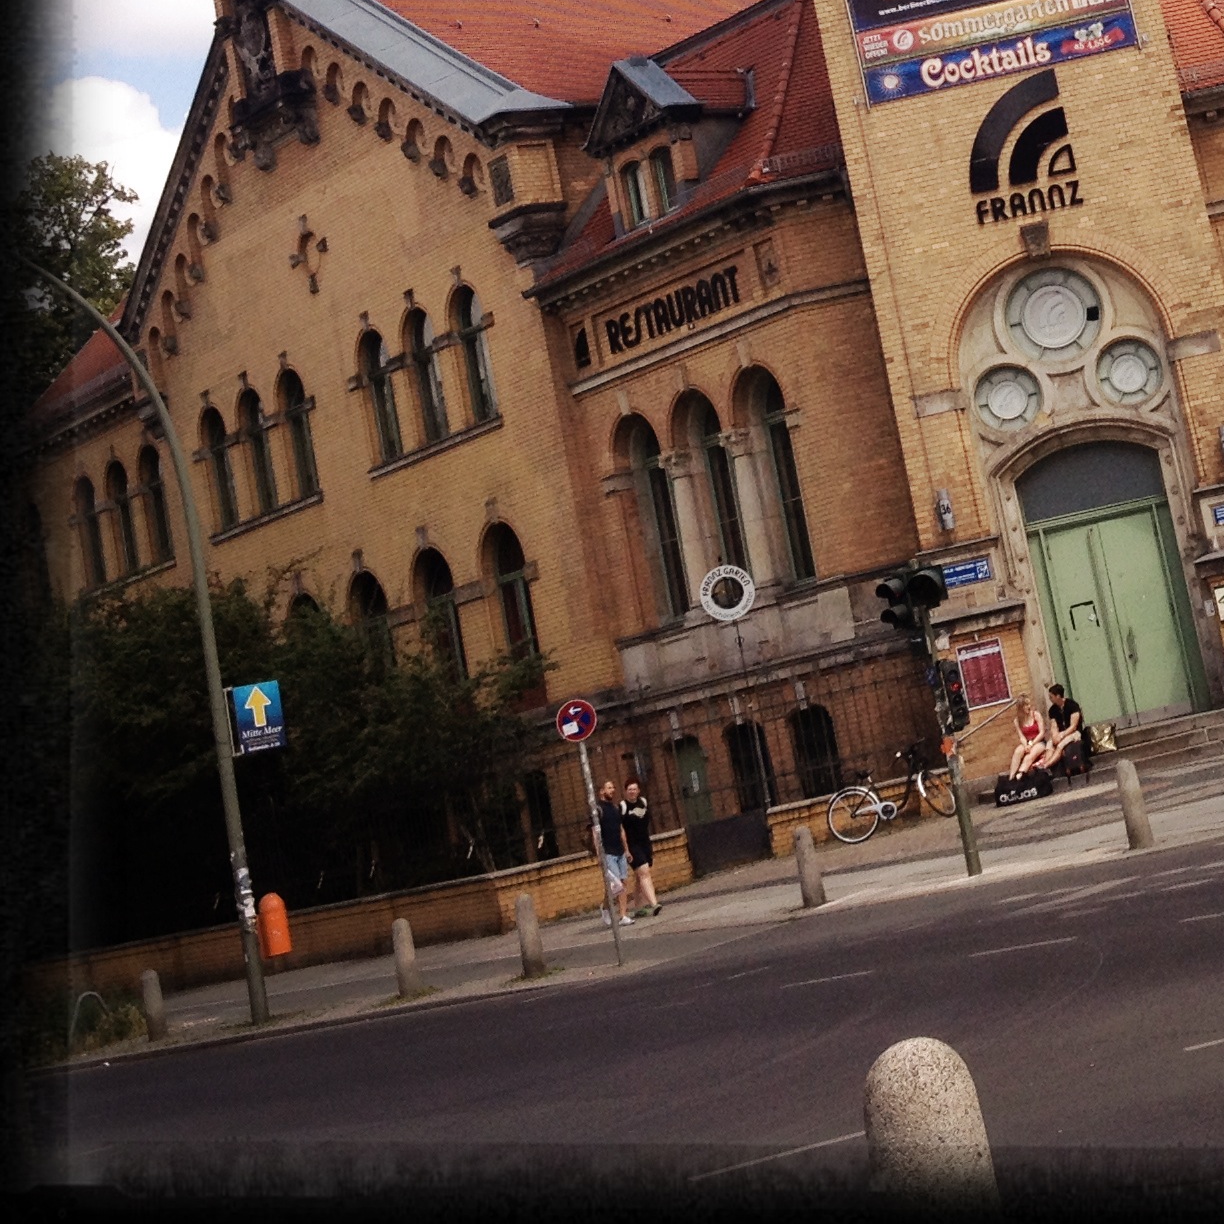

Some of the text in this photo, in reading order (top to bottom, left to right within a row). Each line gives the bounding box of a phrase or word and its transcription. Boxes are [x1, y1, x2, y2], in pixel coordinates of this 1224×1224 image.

[863, 34, 881, 44] JETZT
[920, 36, 1052, 88] Cocktails
[976, 180, 1084, 224] FRANNZ
[606, 265, 740, 354] RESTAURANT
[702, 567, 751, 597] FRANNZ GARTEN
[242, 726, 282, 739] Mitte Meer
[1000, 787, 1038, 803] adidas
